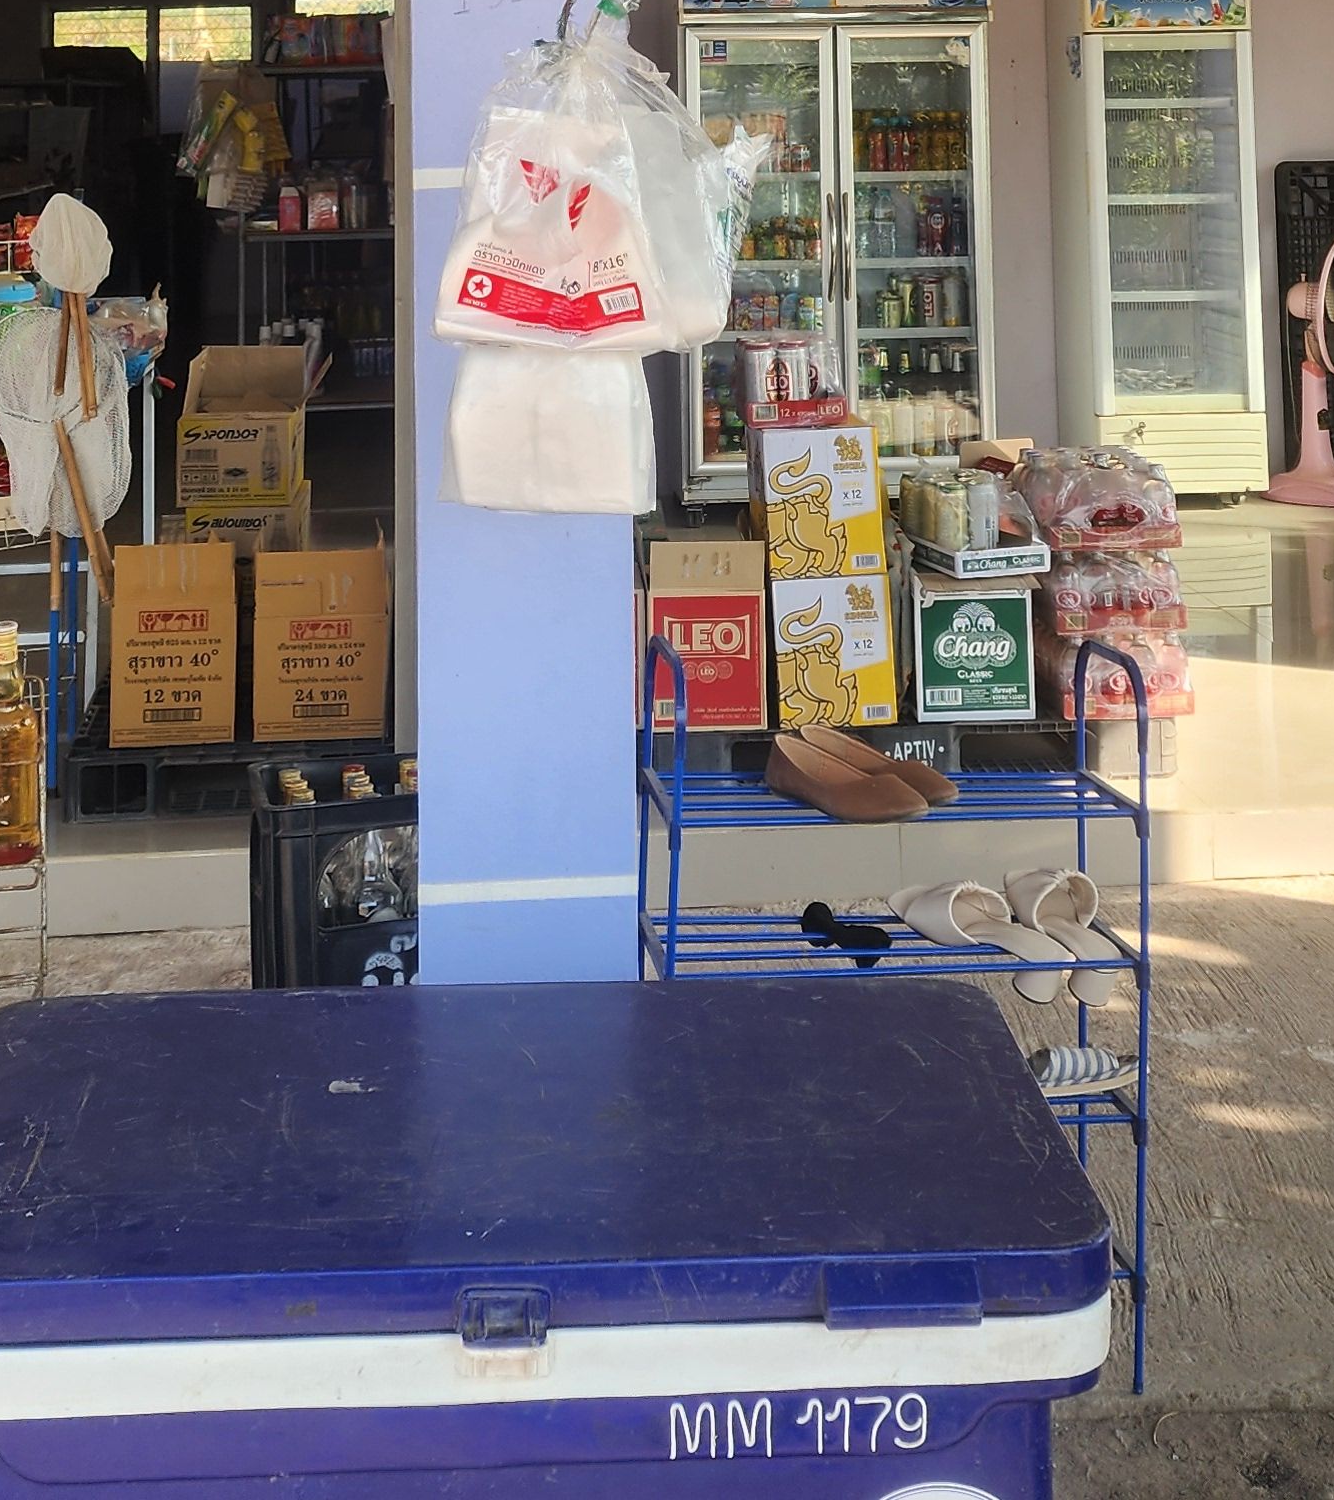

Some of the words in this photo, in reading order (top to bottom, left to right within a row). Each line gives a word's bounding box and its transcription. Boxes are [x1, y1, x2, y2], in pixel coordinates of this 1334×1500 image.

[780, 408, 791, 417] 12
[819, 405, 841, 417] LEO
[201, 428, 260, 441] SPONSOR
[852, 490, 862, 499] 12
[979, 559, 1007, 570] Chang
[672, 621, 744, 654] LEO
[863, 639, 873, 649] 12
[938, 635, 1011, 660] Chang
[127, 654, 183, 675] สุราขาว
[281, 656, 330, 674] สุราขาว
[700, 668, 715, 676] LEO
[143, 688, 165, 703] 12
[171, 689, 202, 702] ขวด
[295, 688, 314, 702] 24
[320, 689, 347, 701] ขวด
[893, 739, 936, 761] APTIV
[669, 1397, 773, 1461] MM
[795, 1392, 929, 1456] 1179
